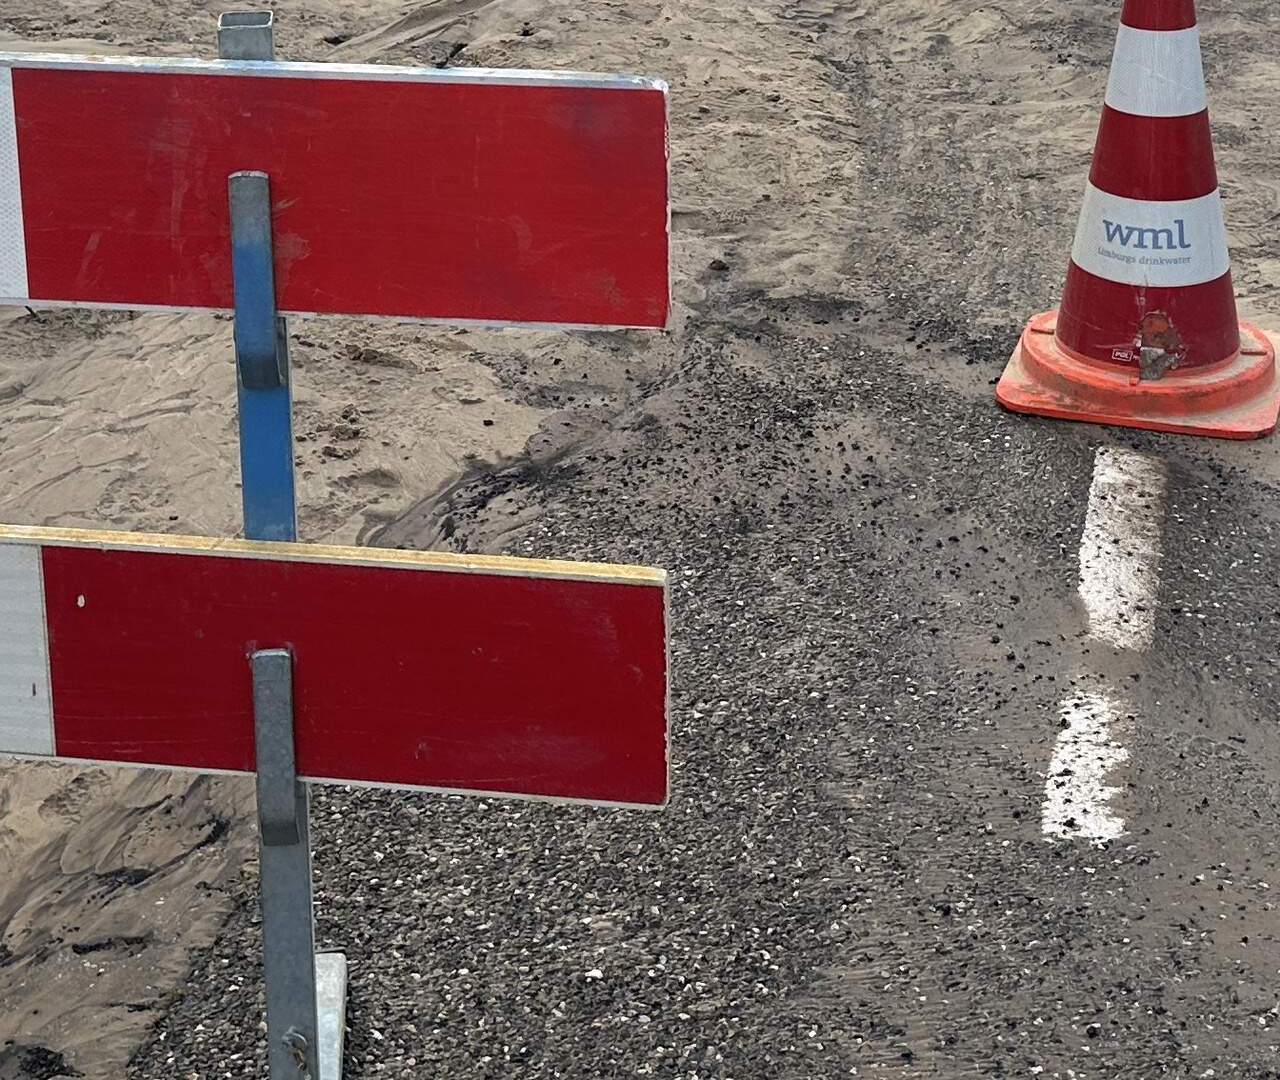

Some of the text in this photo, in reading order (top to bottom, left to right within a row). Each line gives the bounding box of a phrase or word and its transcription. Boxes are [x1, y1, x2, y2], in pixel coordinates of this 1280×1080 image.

[1102, 219, 1191, 250] wml
[1097, 247, 1192, 266] Limburgs drinkwater
